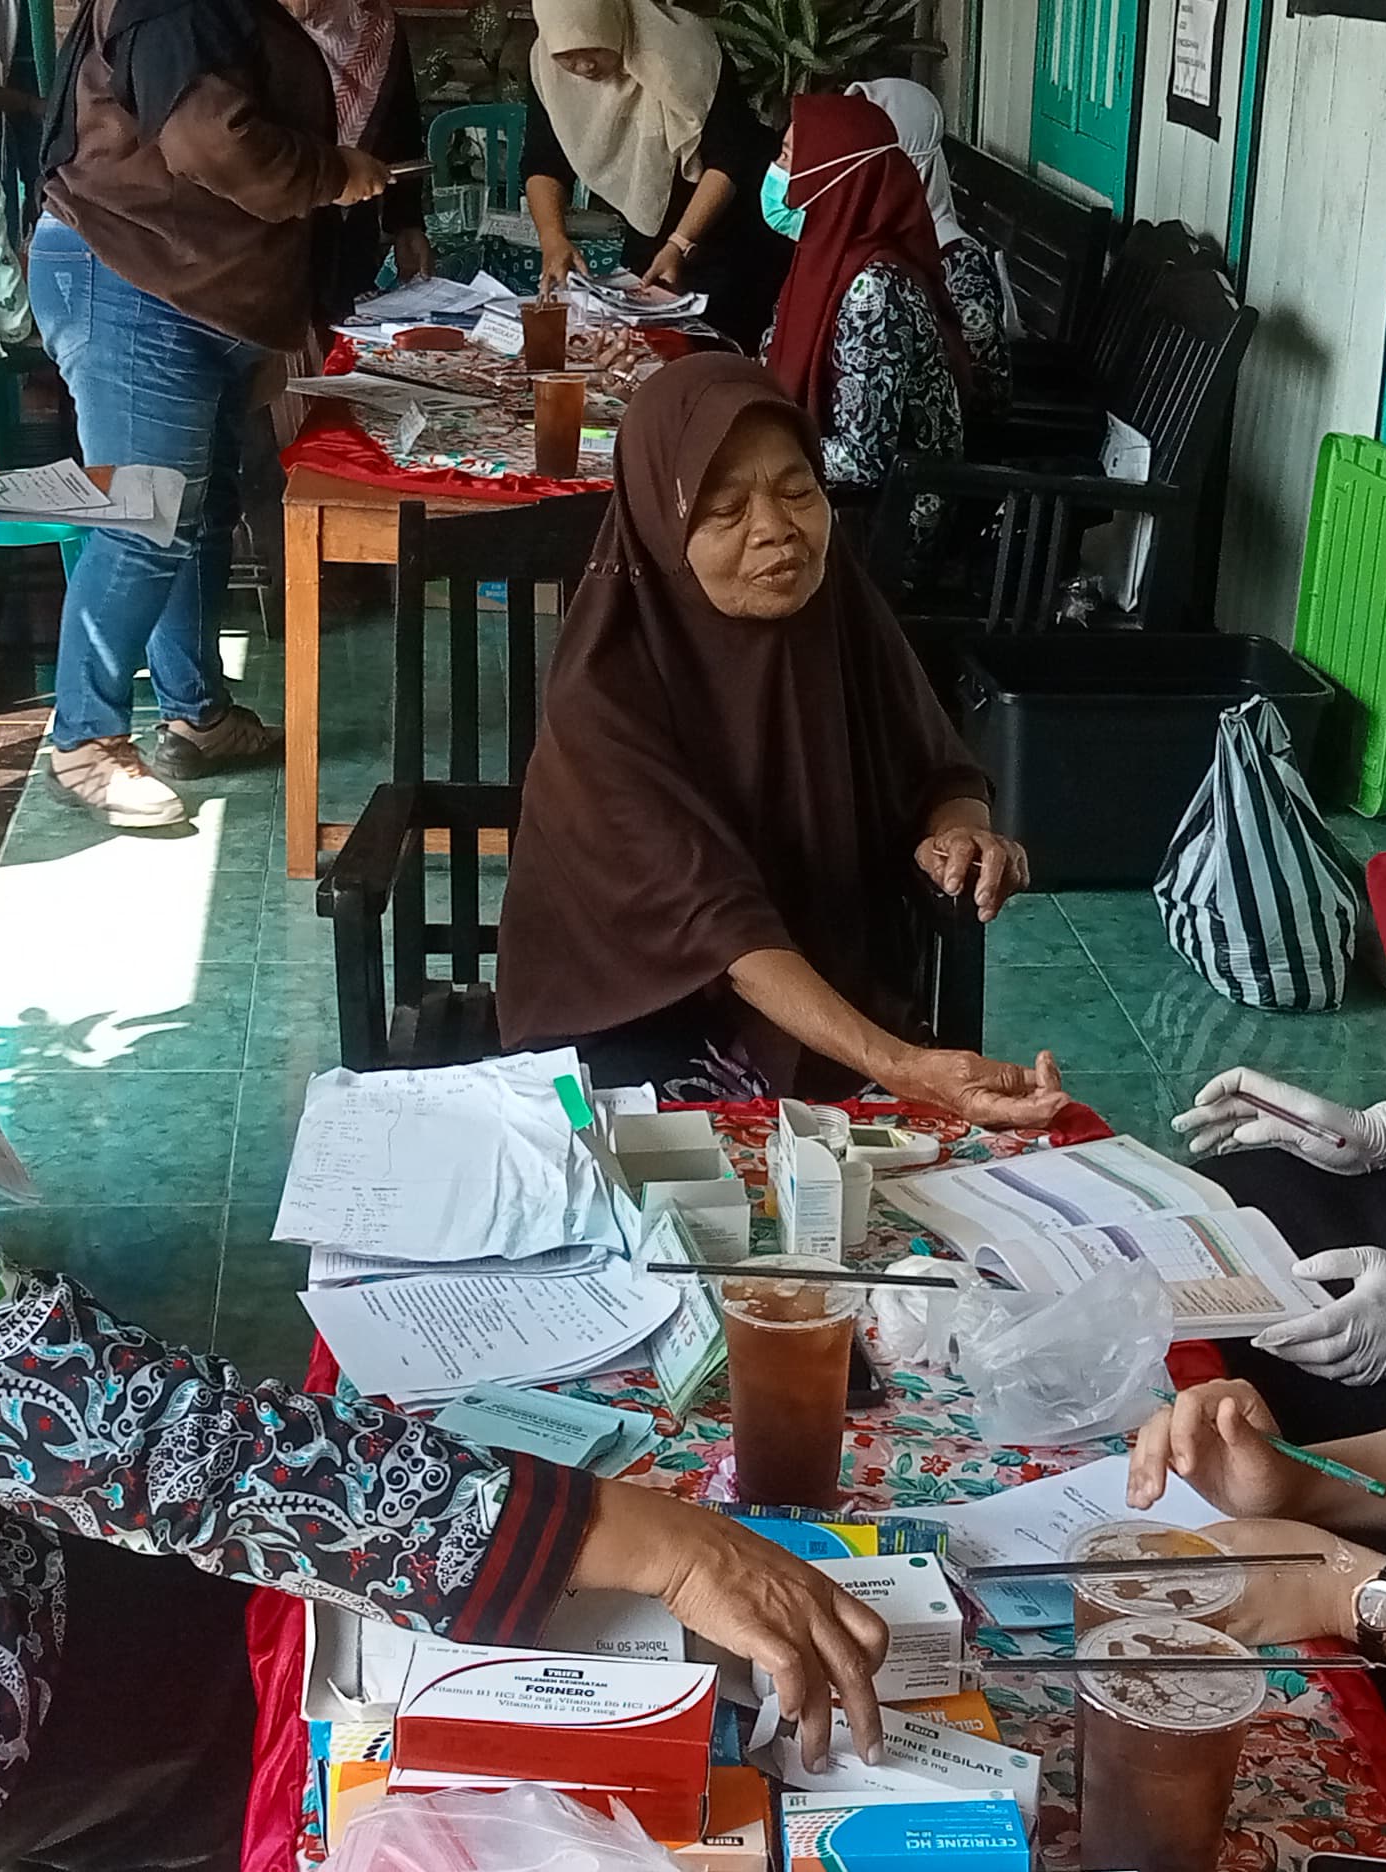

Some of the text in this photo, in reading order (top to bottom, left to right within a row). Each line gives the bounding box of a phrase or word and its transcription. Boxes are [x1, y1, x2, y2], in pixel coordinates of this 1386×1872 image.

[872, 1588, 889, 1597] mg
[596, 1639, 669, 1652] Tablet 50 mg
[431, 1685, 474, 1695] Vitamin
[518, 1693, 533, 1701] 50
[525, 1684, 596, 1697] FORNERO
[498, 1699, 541, 1709] Vitamin
[571, 1705, 591, 1713] 100
[885, 1745, 918, 1764] Tablet
[930, 1762, 949, 1774] mg
[931, 1747, 1004, 1778] BESILATE
[935, 1837, 1018, 1849] CETIRIZINE
